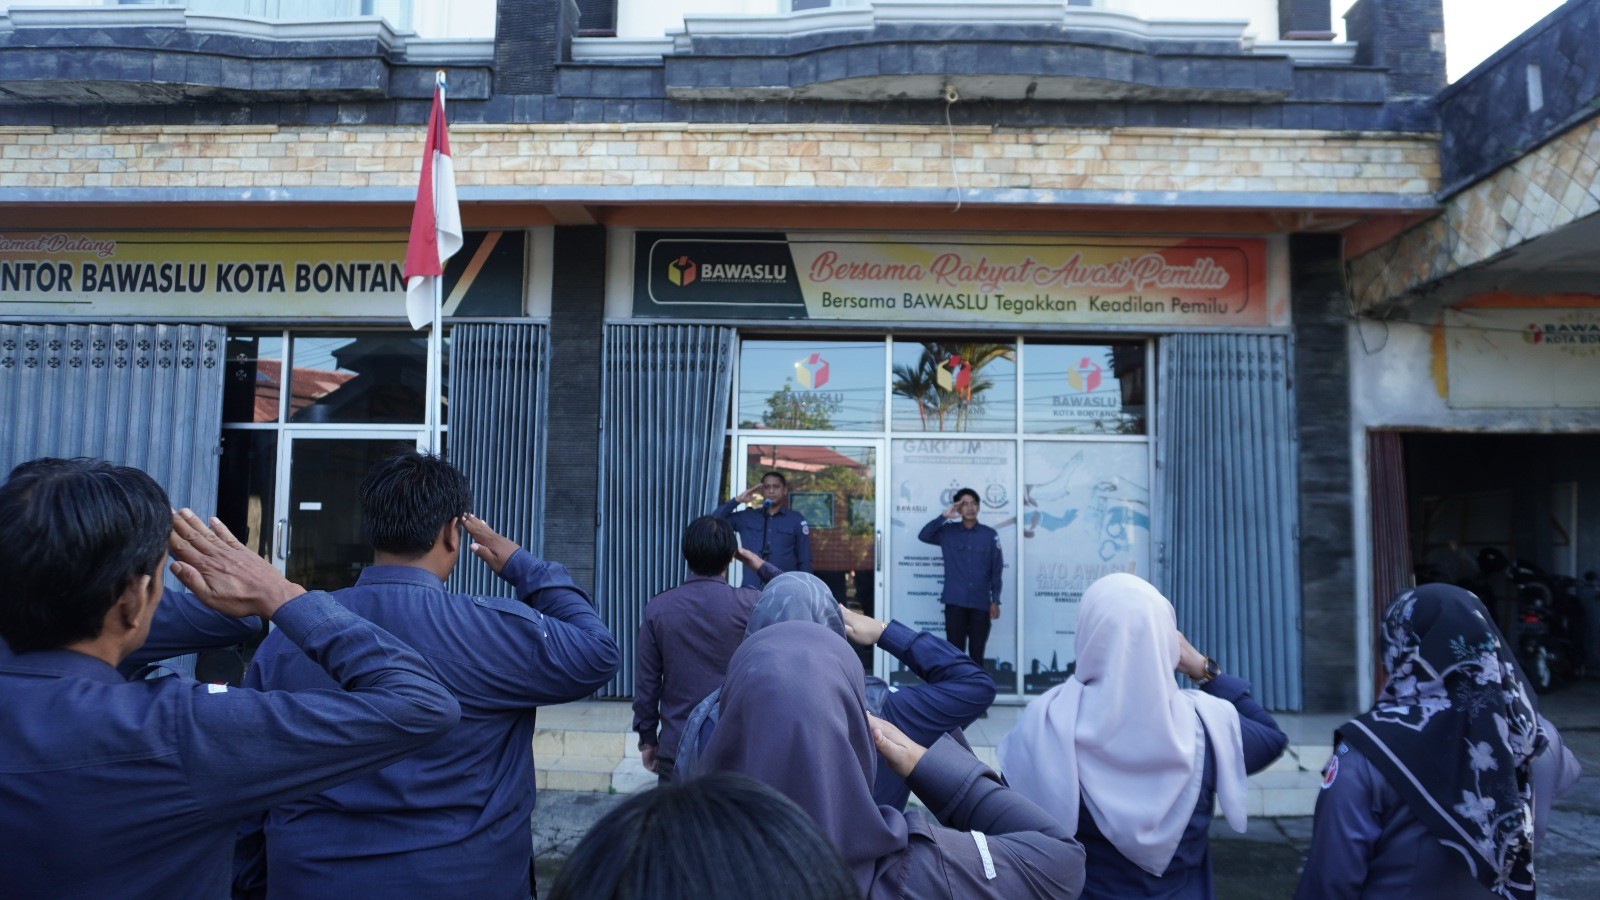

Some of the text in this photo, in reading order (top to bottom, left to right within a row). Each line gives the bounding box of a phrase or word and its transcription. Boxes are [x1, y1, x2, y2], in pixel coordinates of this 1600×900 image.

[0, 234, 115, 257] amat Datang
[1, 262, 408, 293] NTOR BAWASLU KOTA BONTAN
[701, 264, 787, 279] BAWASLU
[809, 251, 1230, 293] Bersama Rakyat Awasi Pemilu
[822, 292, 1228, 314] Bersama BAWASLU Tegakkan Keadilan Pemilu
[1545, 335, 1576, 343] KOTA
[1053, 396, 1116, 407] BAWASLU
[1037, 562, 1068, 580] AYO
